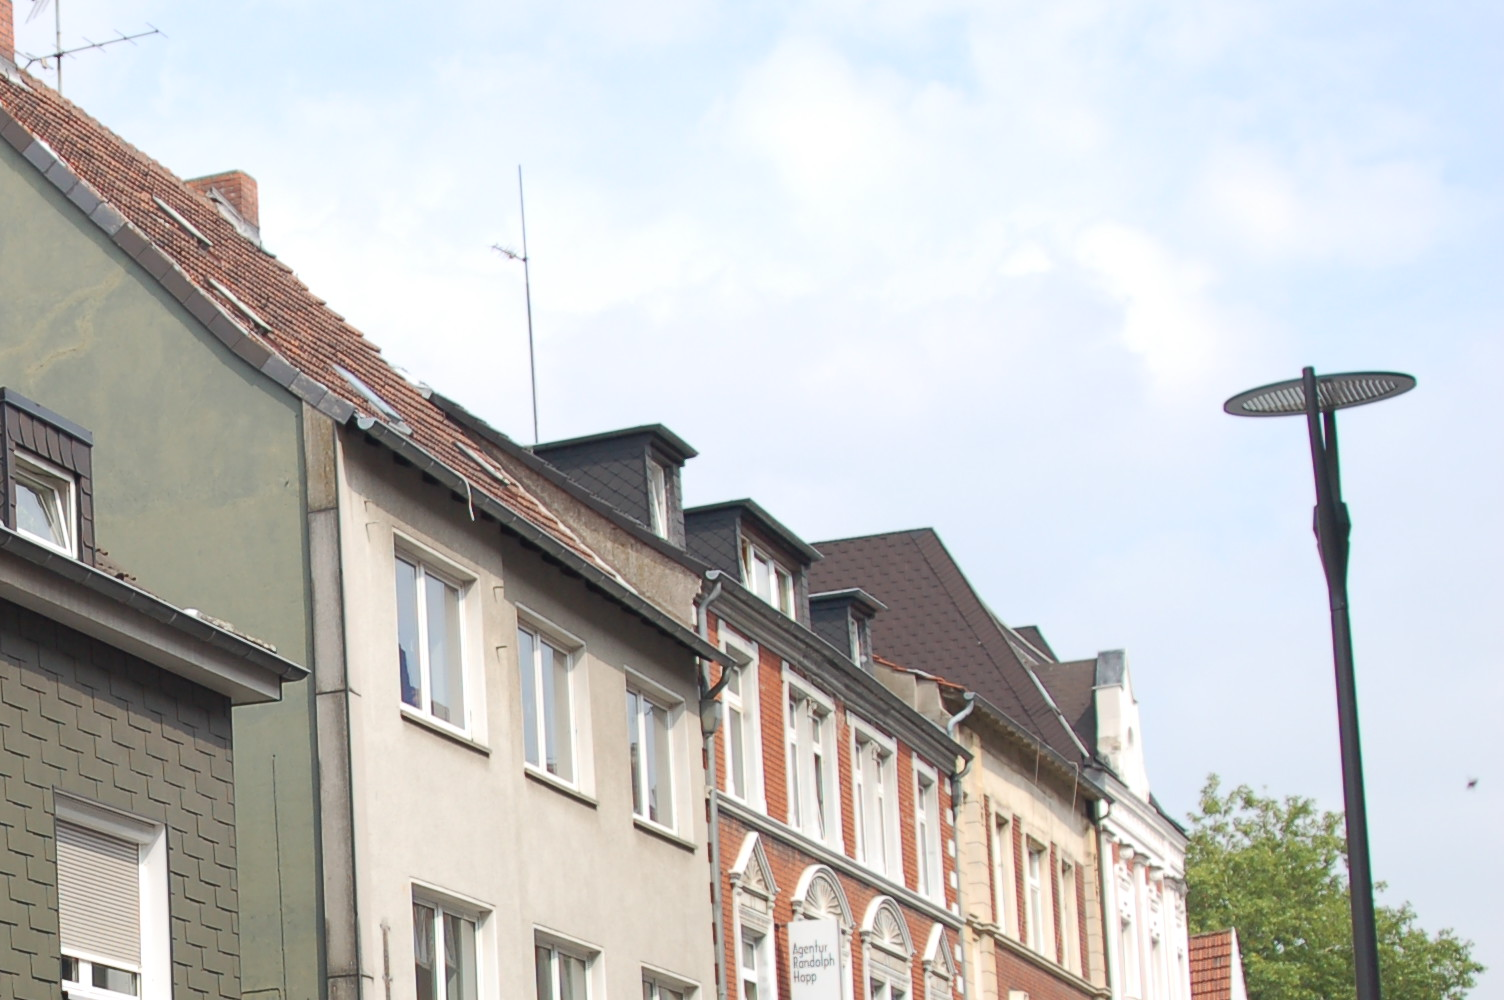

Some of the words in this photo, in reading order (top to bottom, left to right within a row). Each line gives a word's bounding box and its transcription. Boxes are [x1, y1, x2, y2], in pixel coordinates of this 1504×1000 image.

[793, 940, 827, 958] Agentur
[793, 953, 835, 970] Randolph
[793, 970, 817, 985] Hopp
